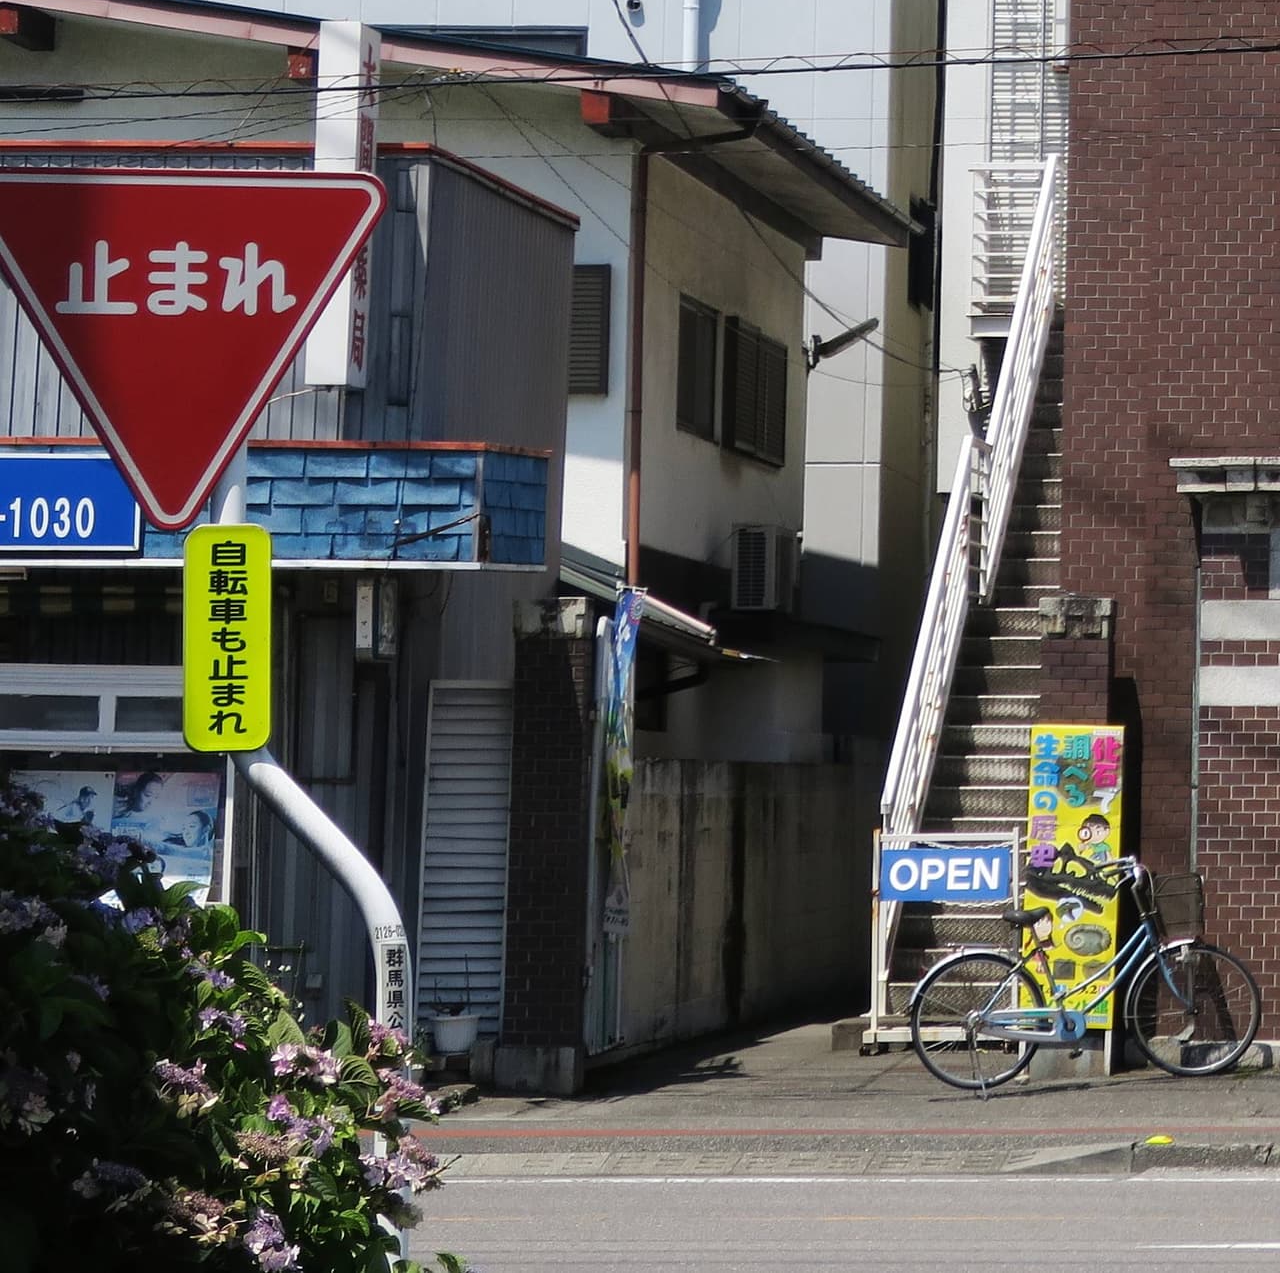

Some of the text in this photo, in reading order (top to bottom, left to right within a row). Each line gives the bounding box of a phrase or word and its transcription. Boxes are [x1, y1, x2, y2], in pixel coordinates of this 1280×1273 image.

[349, 43, 377, 373] 大間薬局
[55, 240, 297, 315] 止まれ
[208, 540, 249, 735] 自転車も止まれ
[1030, 734, 1061, 868] 生命の歴史
[1062, 735, 1090, 807] 調べる
[1091, 735, 1122, 815] 化石で
[889, 858, 1000, 892] OPEN
